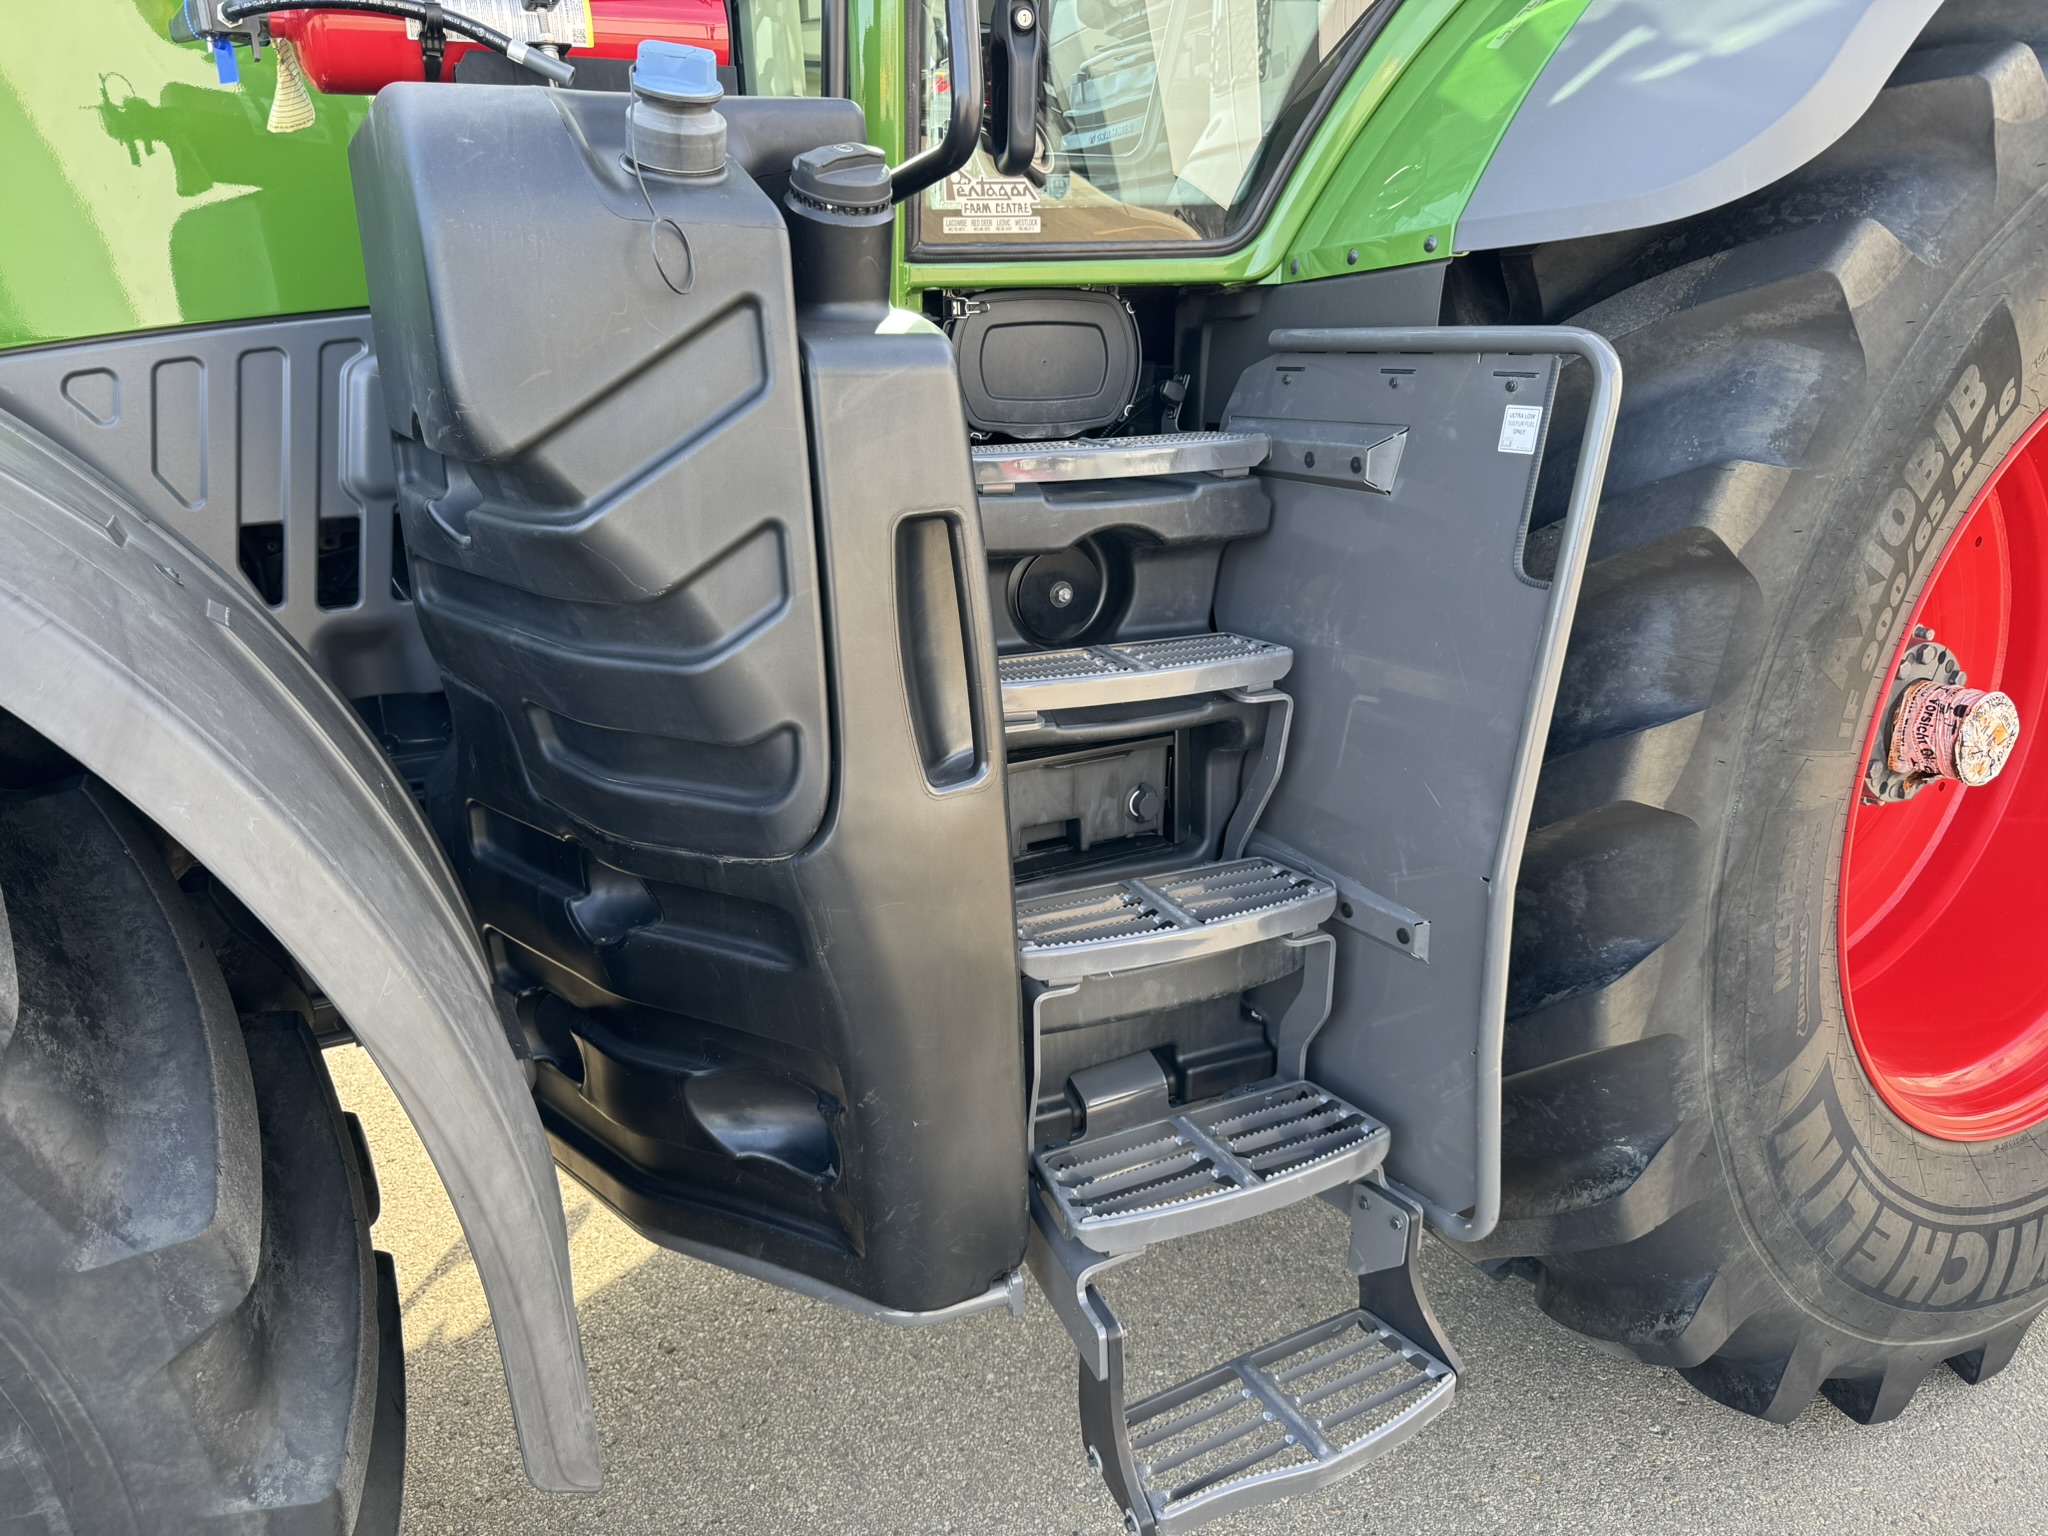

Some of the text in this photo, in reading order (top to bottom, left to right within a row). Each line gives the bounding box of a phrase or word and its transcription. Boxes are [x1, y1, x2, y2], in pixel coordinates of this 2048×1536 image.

[945, 219, 1038, 227] LACOMBE RED DEER LEDUC WESTLOCK
[963, 202, 1030, 214] FARM CENTRE
[1860, 493, 1947, 673] 900/65
[1951, 446, 1973, 491] R
[1981, 376, 2017, 441] 46
[1774, 1098, 2048, 1307] MICHELIN
